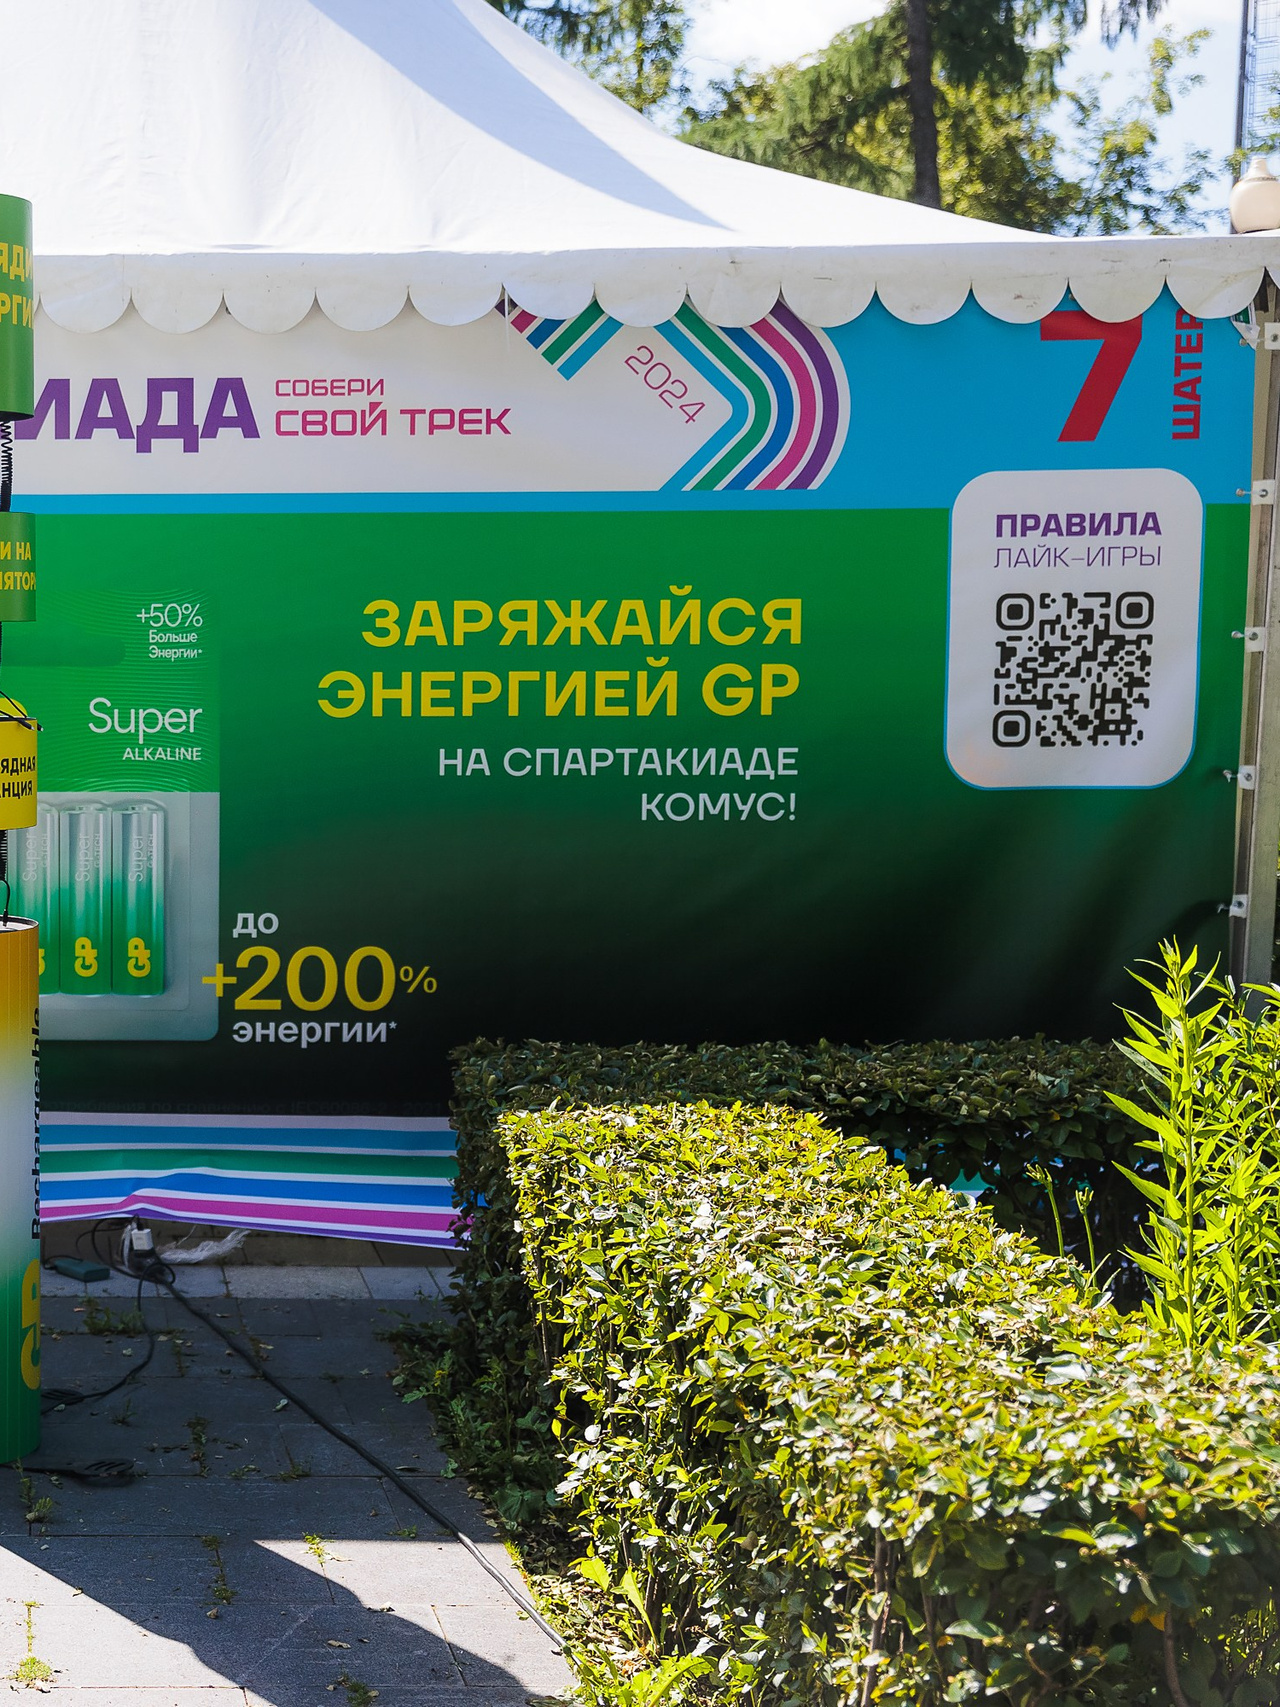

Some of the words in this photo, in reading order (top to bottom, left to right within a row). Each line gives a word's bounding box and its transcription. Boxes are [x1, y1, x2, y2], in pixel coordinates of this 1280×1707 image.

[275, 378, 385, 397] СОБЕРИ
[624, 345, 706, 425] 2024
[1040, 310, 1143, 442] 7
[275, 402, 388, 437] СВОЙ
[400, 408, 511, 436] ТРЕК
[996, 512, 1162, 538] ПРАВИЛА
[16, 541, 31, 560] НА
[136, 603, 203, 627] +50%
[362, 585, 802, 647] ЗАРЯЖАЙСЯ
[149, 629, 197, 643] Больше
[317, 656, 678, 719] ЭНЕРГИЕЙ
[702, 663, 800, 716] GP
[88, 697, 202, 744] Super
[122, 747, 202, 761] ALKALINE
[438, 748, 491, 776] НА
[503, 747, 799, 780] СПАРТАКИАДЕ
[641, 792, 797, 822] КОМУС!
[232, 912, 279, 938] до
[74, 937, 98, 978] GP
[127, 937, 151, 978] GP
[202, 945, 437, 1011] +200%
